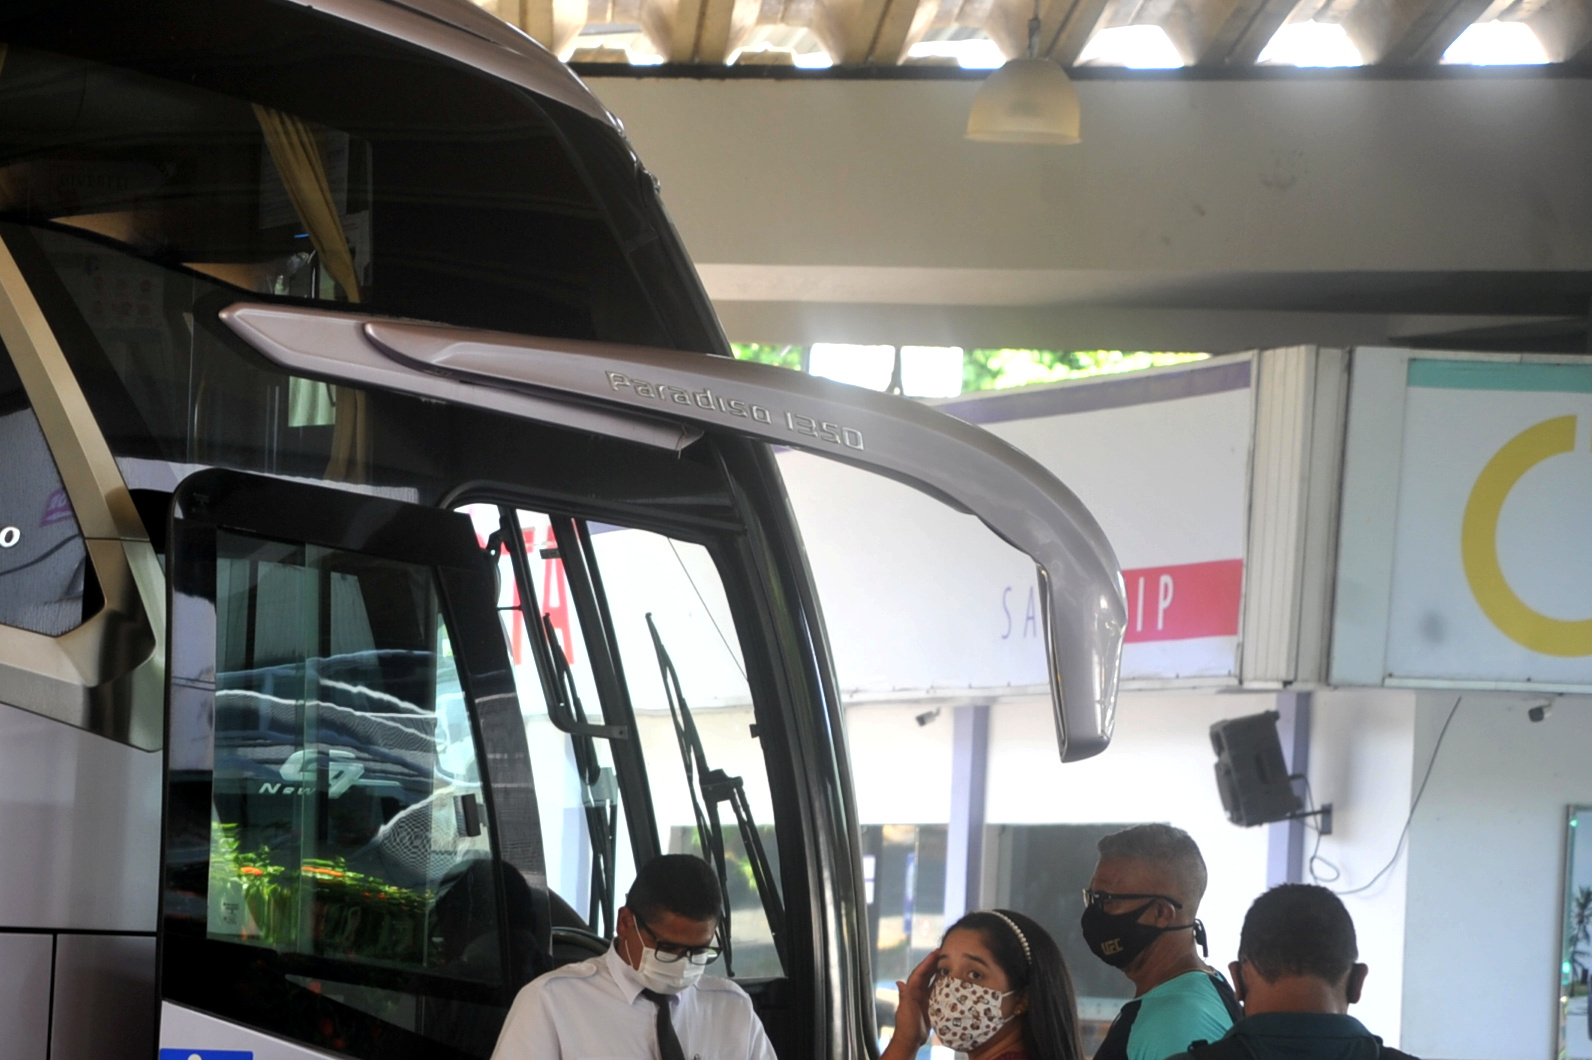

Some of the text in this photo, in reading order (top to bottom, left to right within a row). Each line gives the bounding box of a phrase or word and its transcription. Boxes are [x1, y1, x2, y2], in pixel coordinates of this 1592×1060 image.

[605, 370, 865, 451] Paradiso 1350
[1002, 574, 1174, 639] SA IP
[258, 782, 316, 796] New
